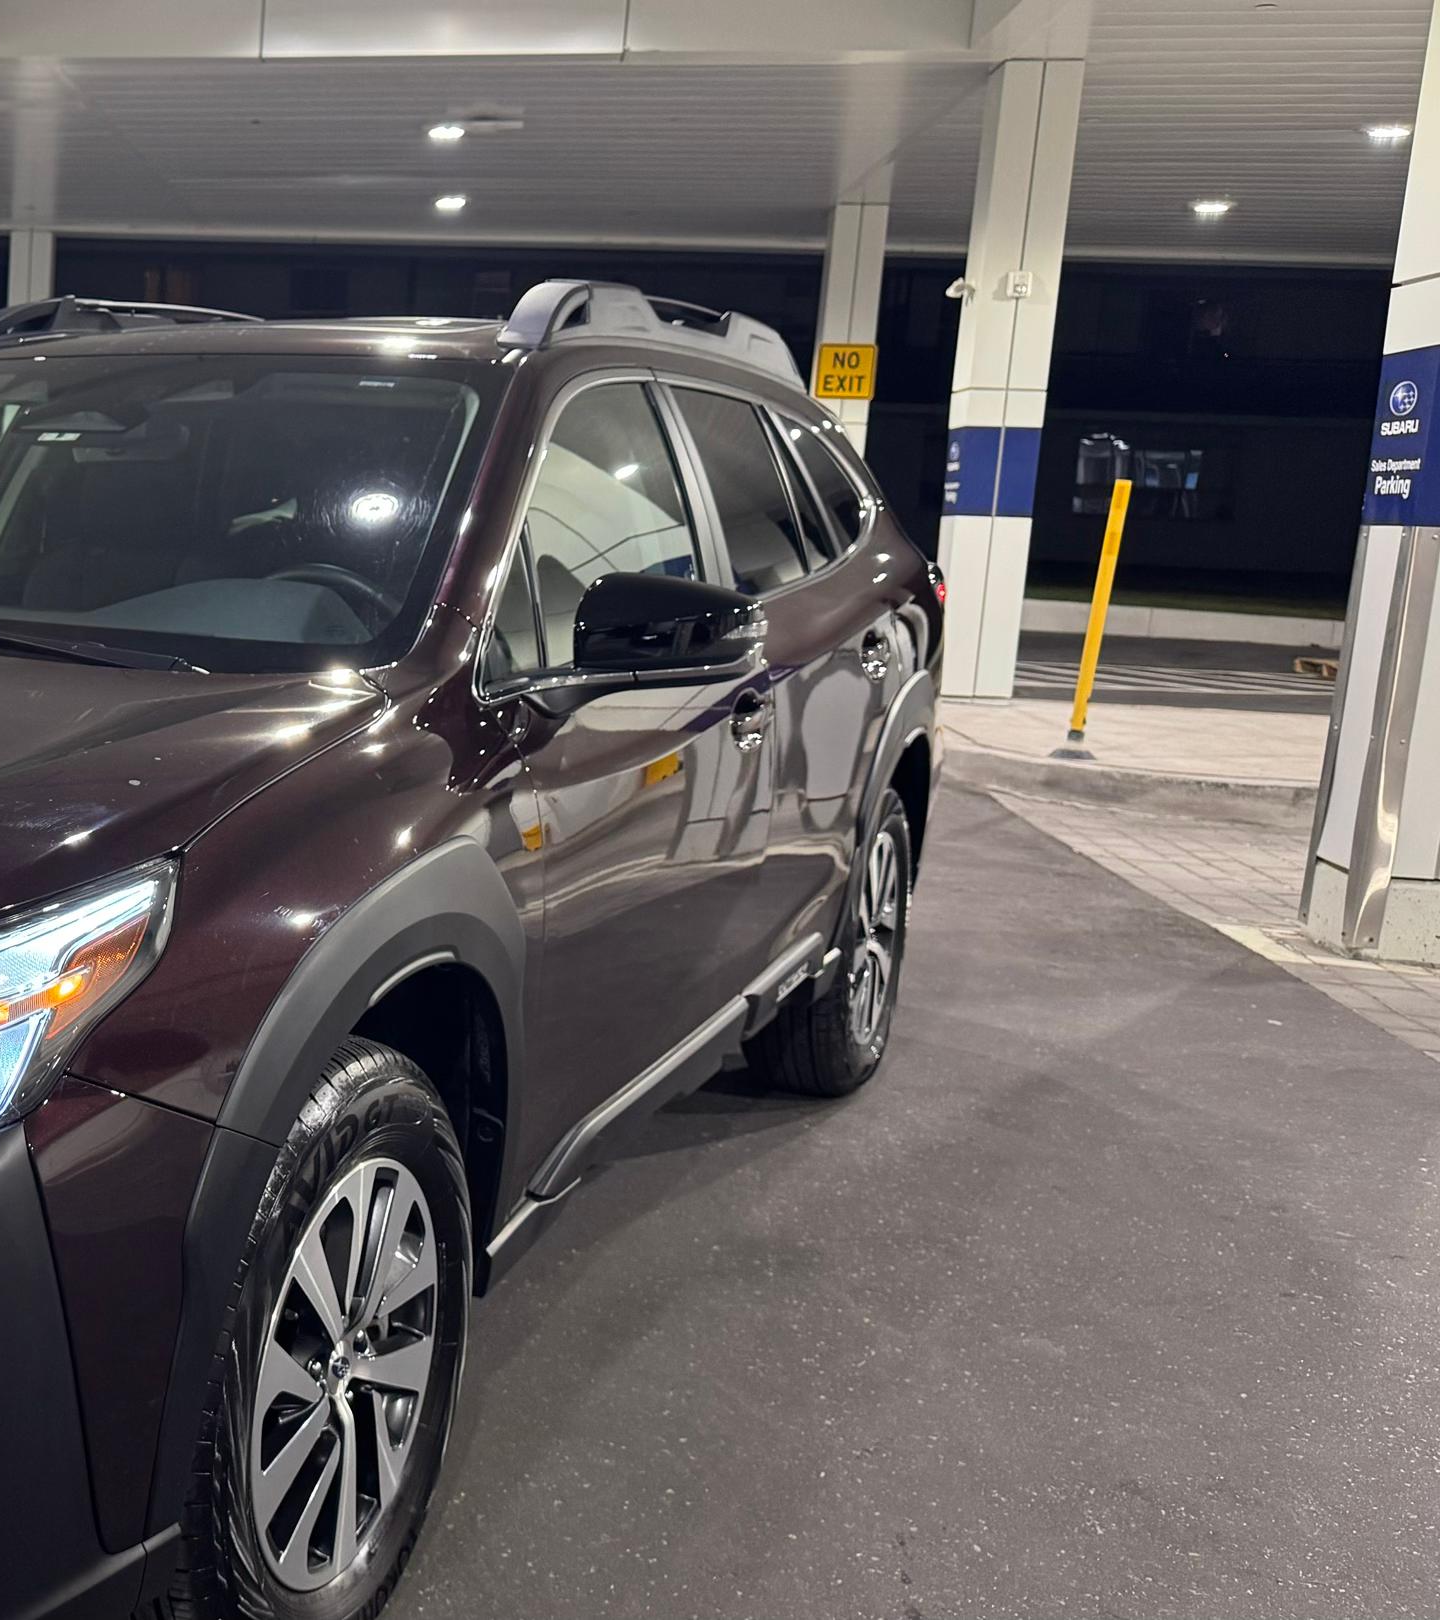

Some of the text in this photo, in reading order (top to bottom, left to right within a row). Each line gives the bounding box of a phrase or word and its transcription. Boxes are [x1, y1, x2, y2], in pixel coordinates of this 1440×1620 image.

[832, 351, 860, 369] NO
[823, 374, 865, 393] EXIT
[1380, 419, 1420, 436] SUBARU
[1370, 458, 1421, 473] Sales Department
[1374, 475, 1411, 499] Parking
